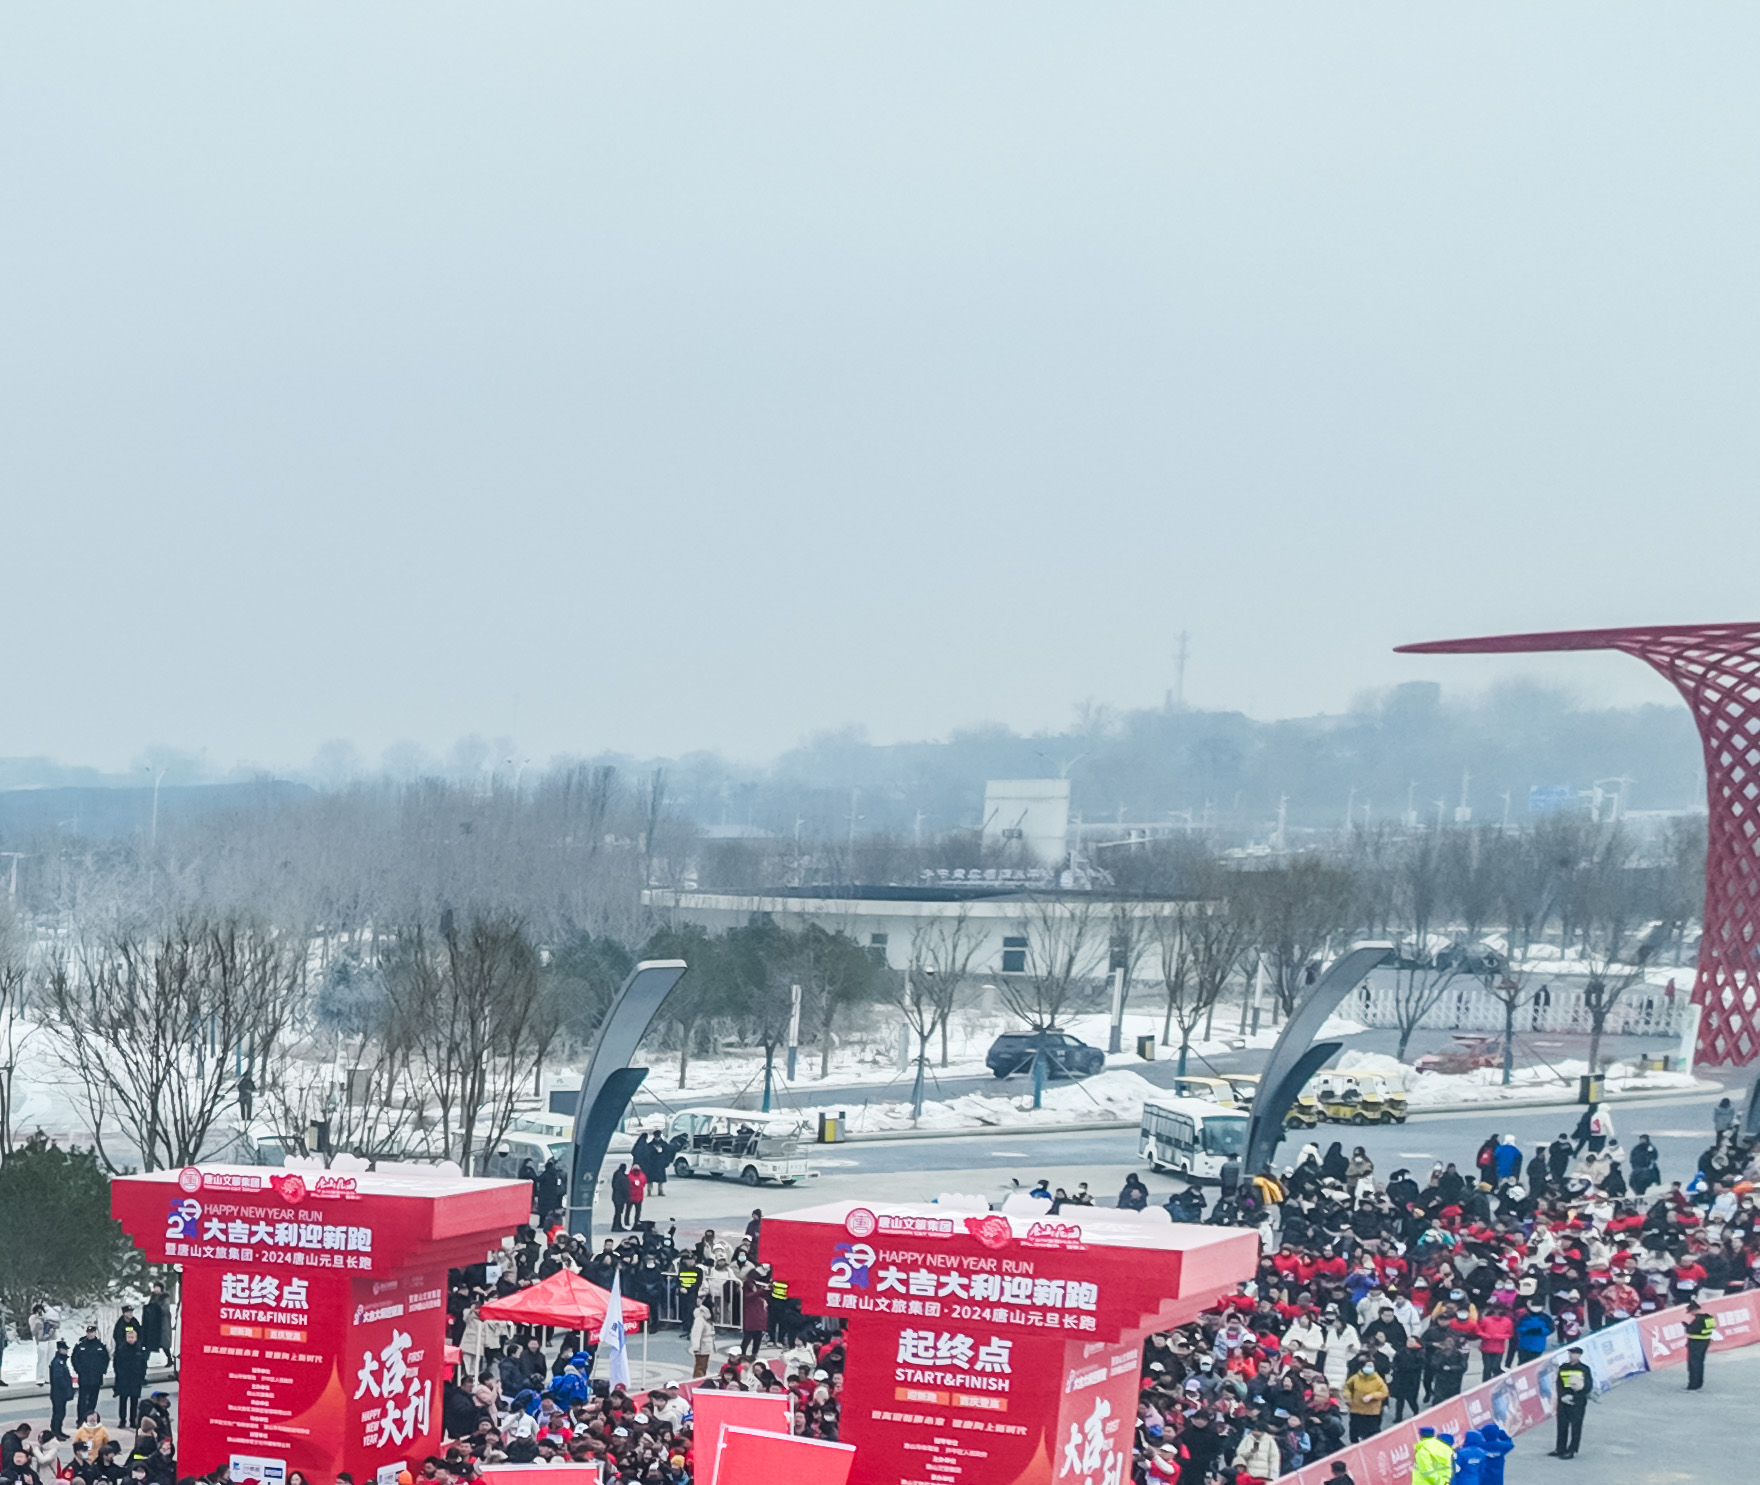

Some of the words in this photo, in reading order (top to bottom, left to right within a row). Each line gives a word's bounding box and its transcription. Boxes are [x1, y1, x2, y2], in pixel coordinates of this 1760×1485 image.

[203, 1204, 240, 1217] HAPPY
[240, 1206, 269, 1218] NEW
[268, 1208, 295, 1220] YEAR
[298, 1210, 323, 1222] RUN
[203, 1217, 373, 1252] 大吉大利迎新跑
[164, 1242, 373, 1270] 暨唐山文旅集团·2024唐山元旦长跑
[879, 1249, 924, 1265] HAPPY
[926, 1254, 961, 1268] NEW
[960, 1256, 997, 1271] YEAR
[1001, 1260, 1034, 1275] RUN
[220, 1272, 309, 1310] 起终点
[876, 1265, 1098, 1311] 大吉大利迎新跑
[219, 1307, 308, 1325] START&FINISH
[825, 1291, 1097, 1332] 暨唐山文旅集团·2024唐山元旦长跑
[896, 1327, 1013, 1374] 起终点
[895, 1367, 1010, 1392] START&FINISH
